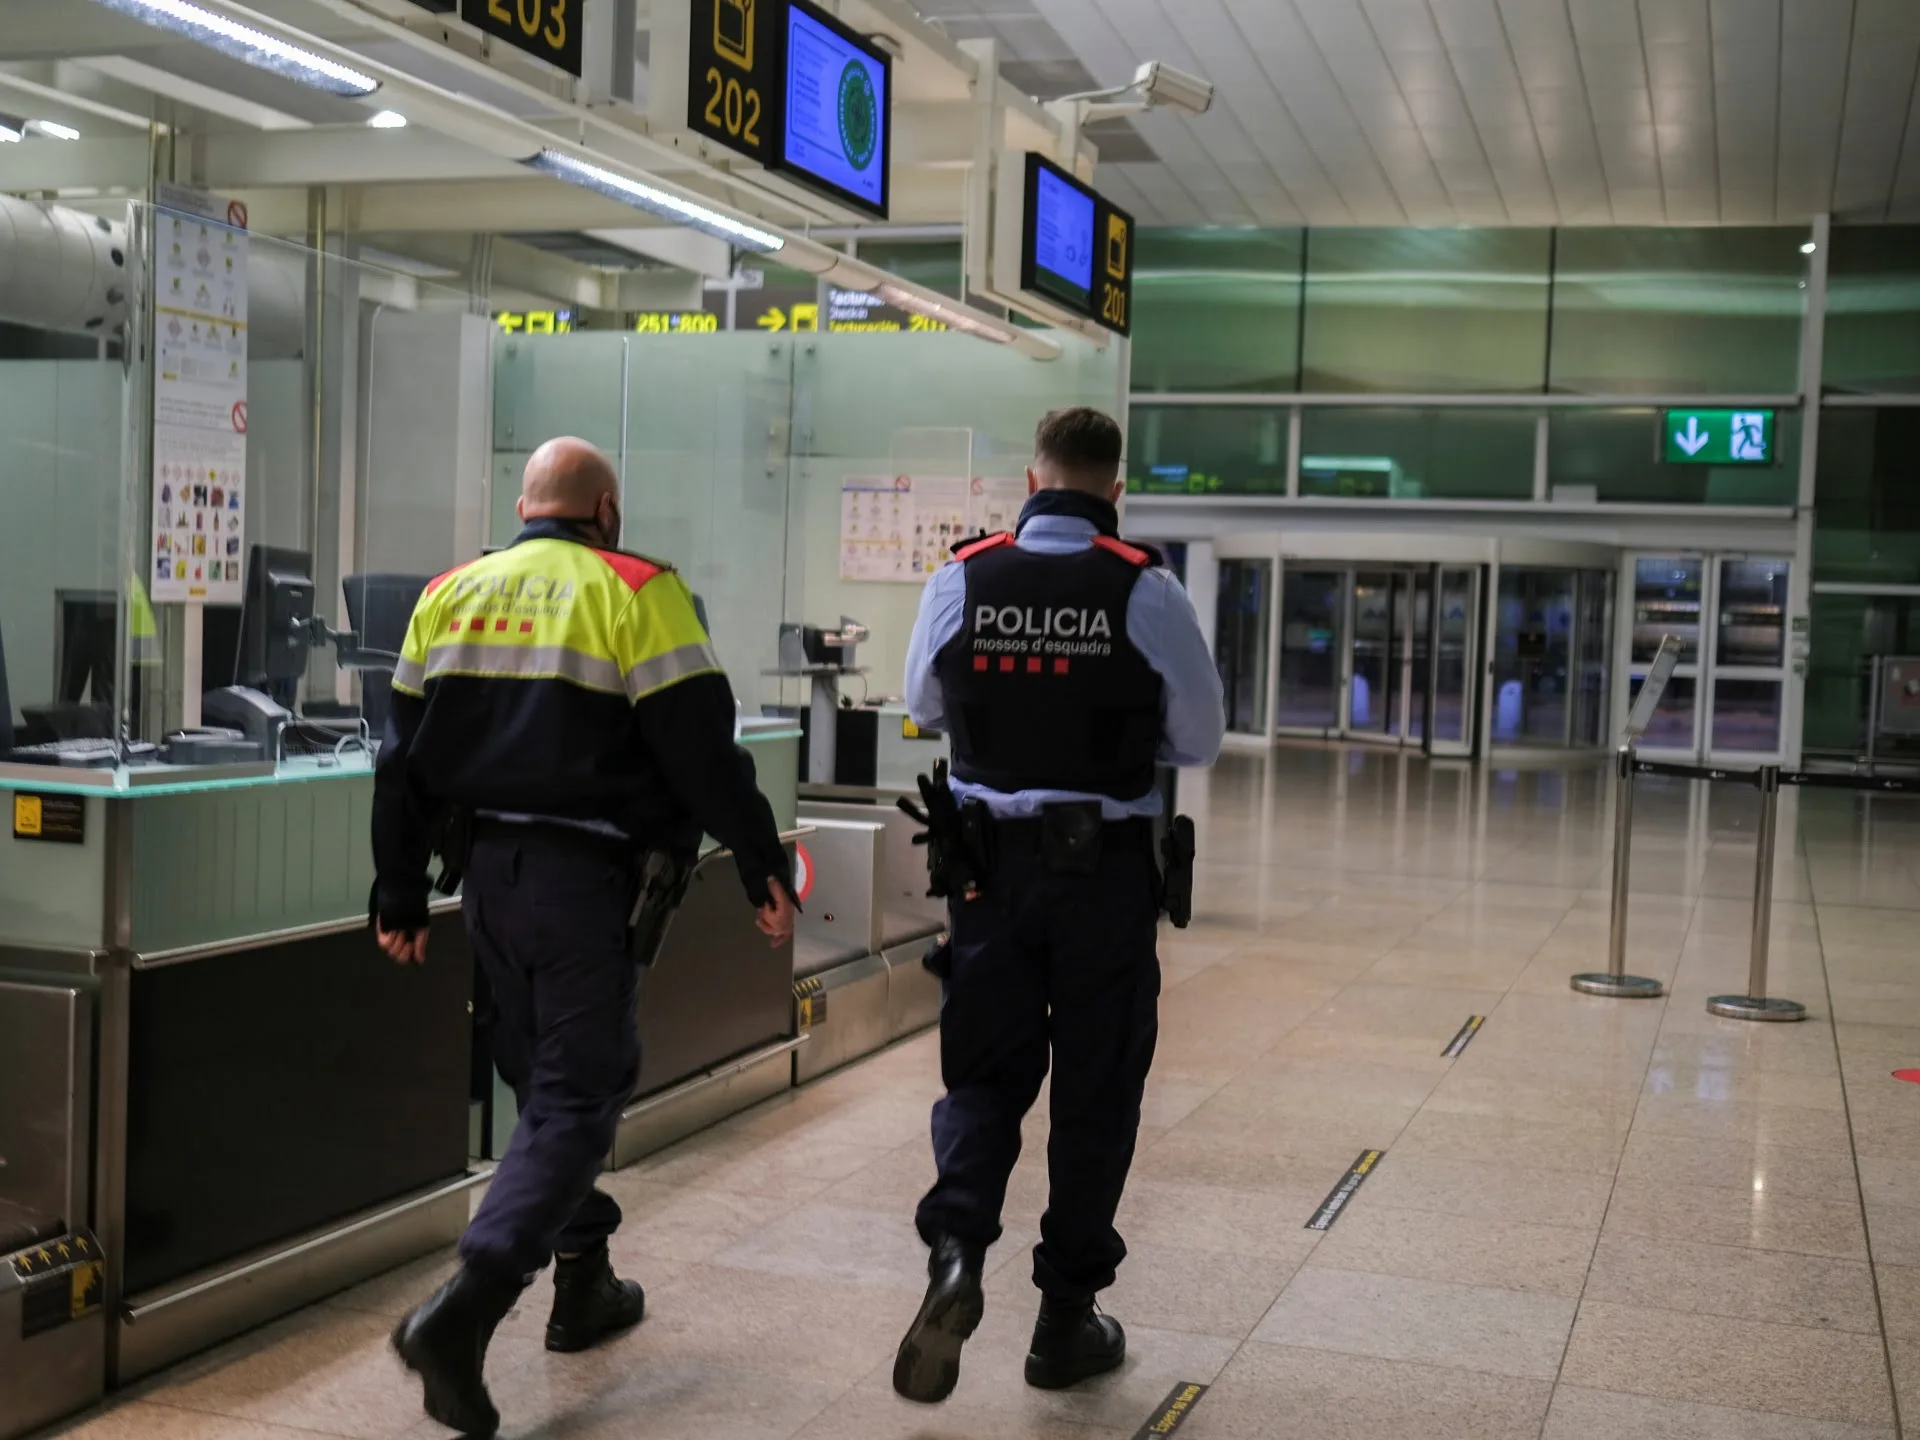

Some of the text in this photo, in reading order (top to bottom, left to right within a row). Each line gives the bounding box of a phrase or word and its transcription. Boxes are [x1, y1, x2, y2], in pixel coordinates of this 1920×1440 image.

[704, 66, 761, 147] 202
[1103, 283, 1126, 327] 201
[455, 575, 575, 601] POLICIA
[974, 605, 1112, 639] POLICIA
[973, 635, 1111, 656] mossos d'esquadra
